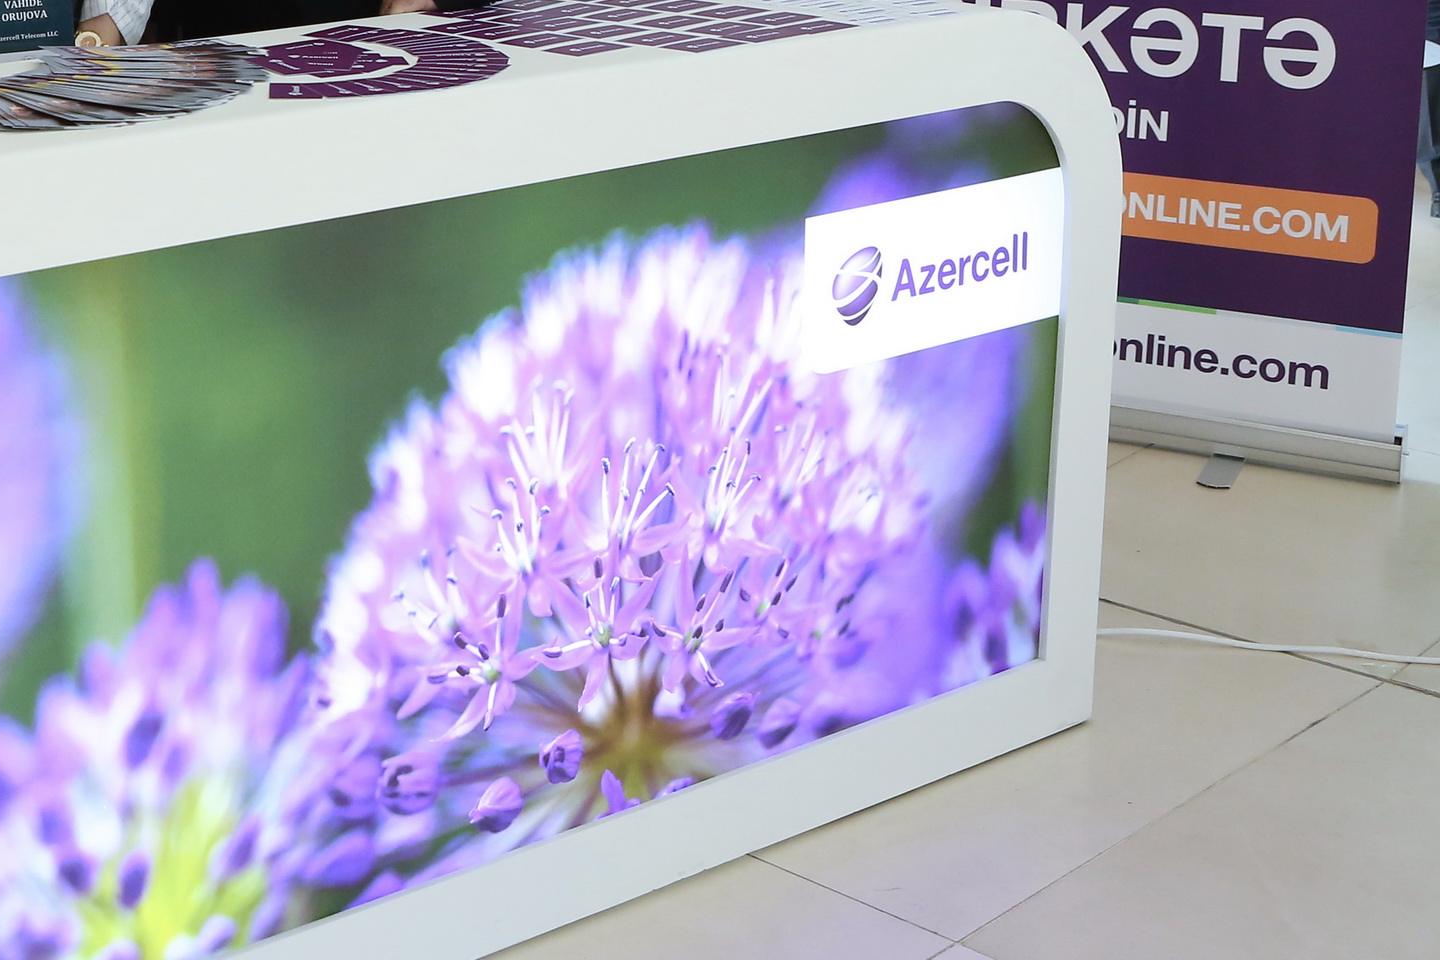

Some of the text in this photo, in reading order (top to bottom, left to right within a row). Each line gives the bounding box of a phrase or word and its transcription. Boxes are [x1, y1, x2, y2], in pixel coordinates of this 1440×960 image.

[1, 10, 48, 22] ORUJOVA
[20, 32, 46, 40] Telecom
[1122, 191, 1350, 243] NLINE.COM
[891, 231, 1028, 302] Azercell
[1113, 334, 1330, 390] nline.com
